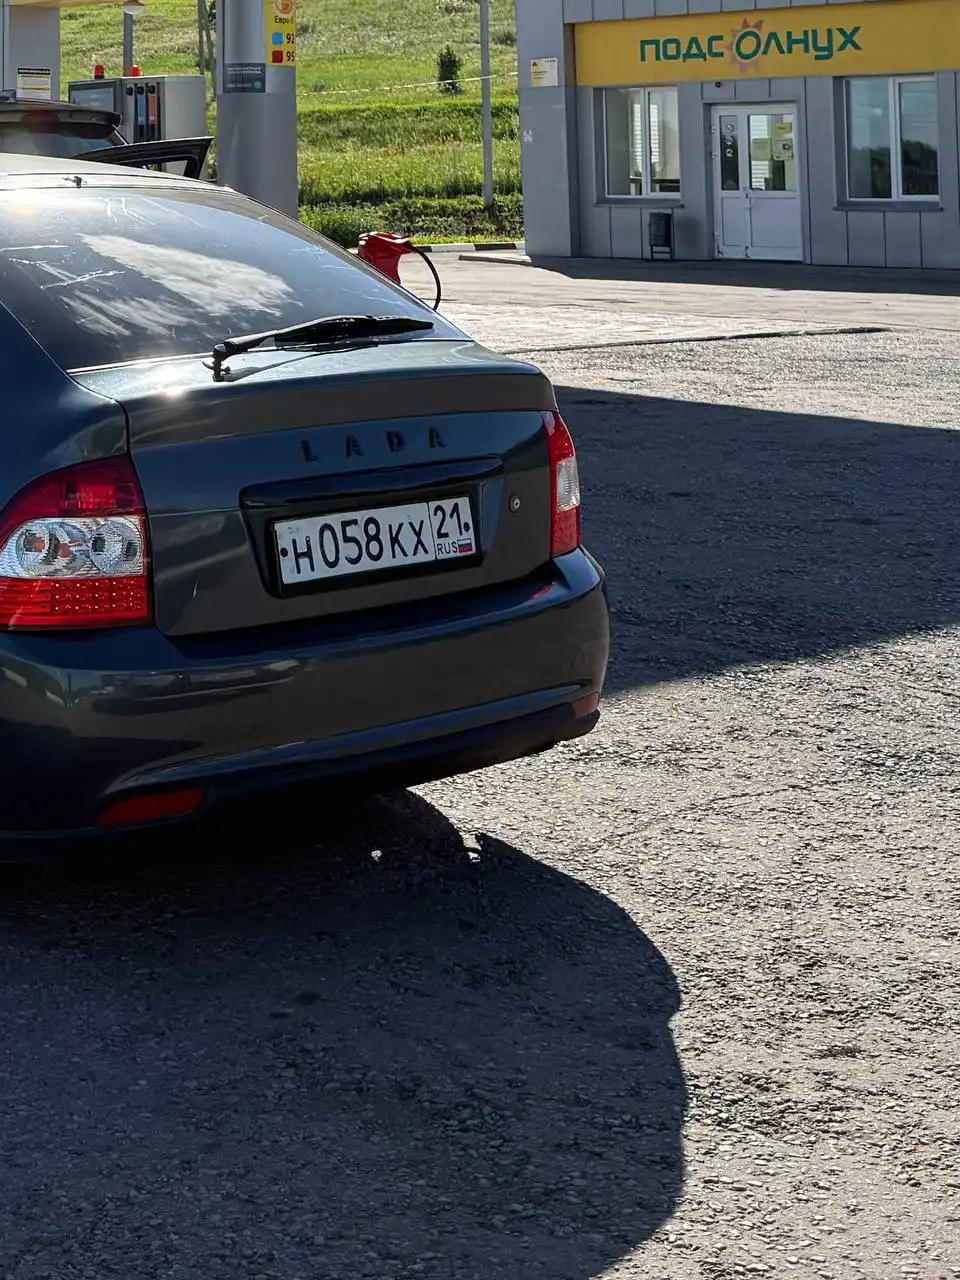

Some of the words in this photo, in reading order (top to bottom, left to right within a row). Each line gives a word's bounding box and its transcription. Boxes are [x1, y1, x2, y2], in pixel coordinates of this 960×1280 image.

[639, 25, 863, 63] ПОДСОЛНУХ
[300, 426, 448, 463] LADA
[433, 502, 464, 540] 21
[436, 542, 458, 556] RUS
